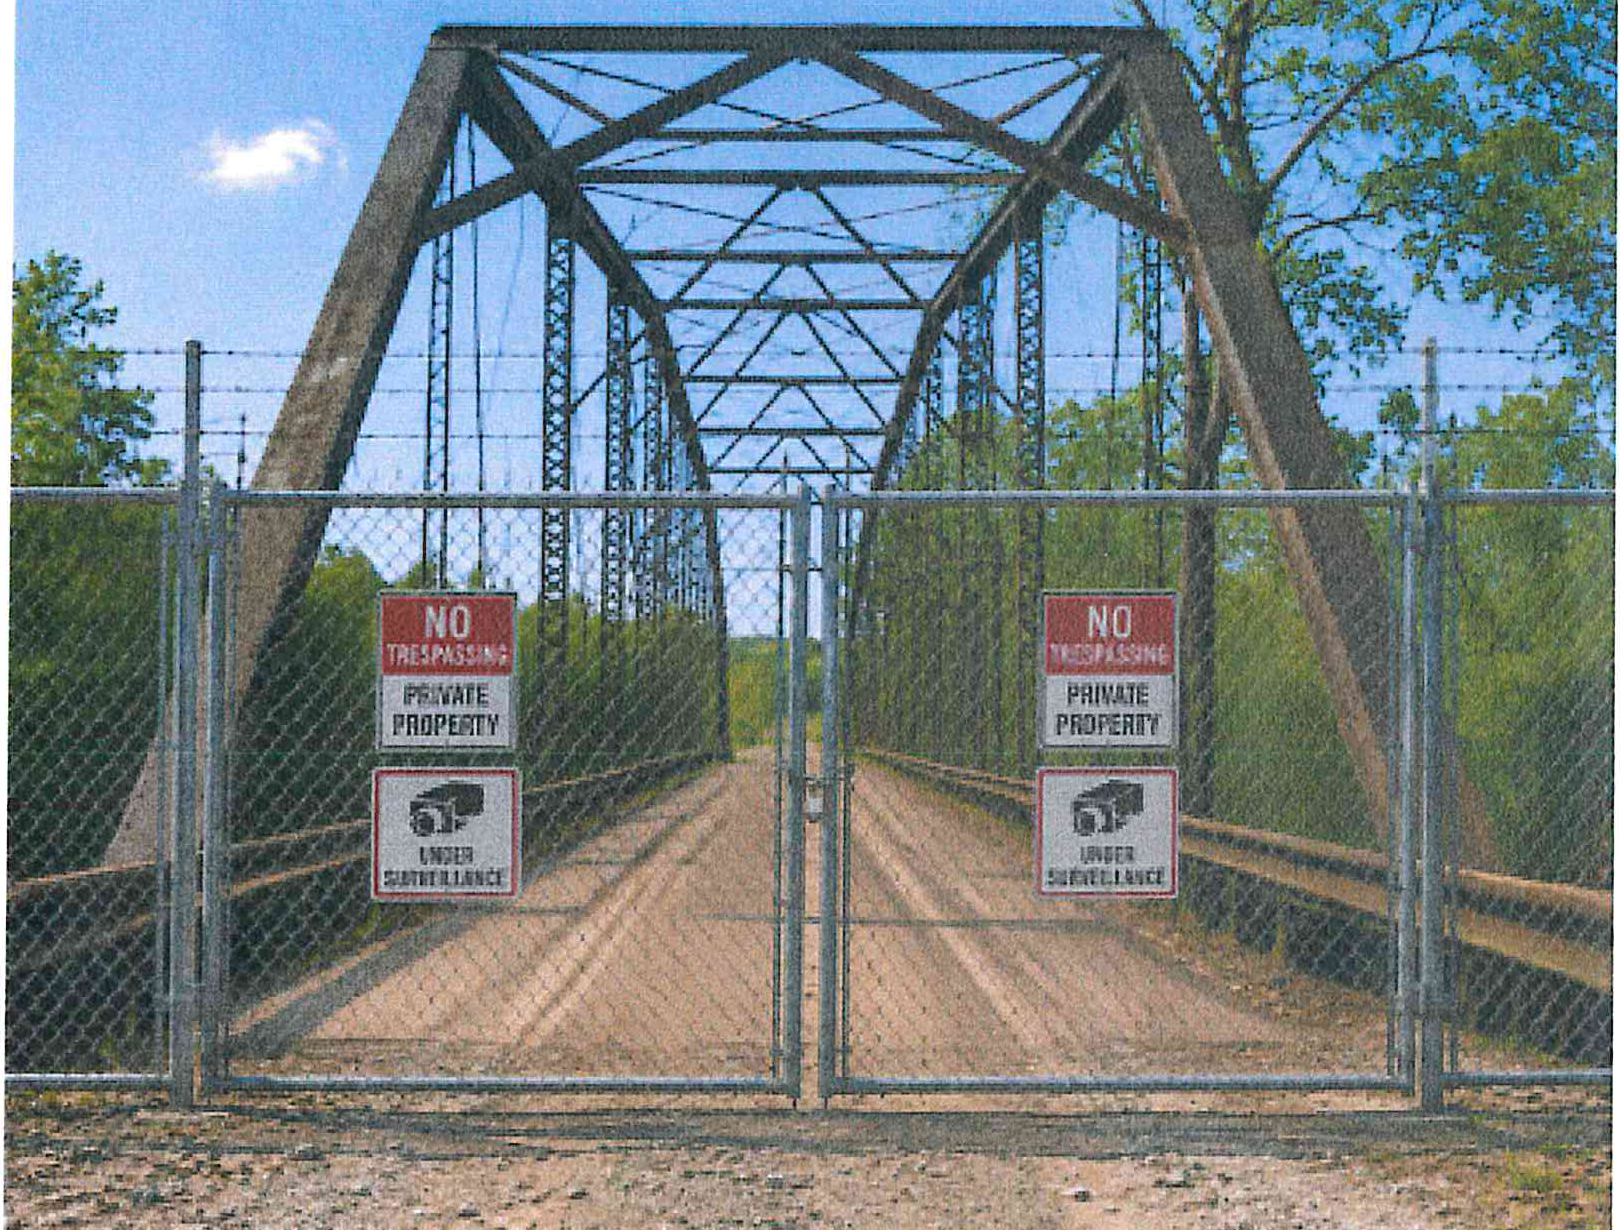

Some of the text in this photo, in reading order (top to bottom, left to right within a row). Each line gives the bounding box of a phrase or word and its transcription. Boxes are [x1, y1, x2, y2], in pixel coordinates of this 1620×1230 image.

[424, 604, 472, 638] NO
[1089, 604, 1133, 638] NO
[403, 682, 490, 706] PRIVATE
[1067, 682, 1150, 706] PRIVATE
[392, 713, 499, 736] PROPERTY
[1056, 713, 1162, 736] PROPERTY
